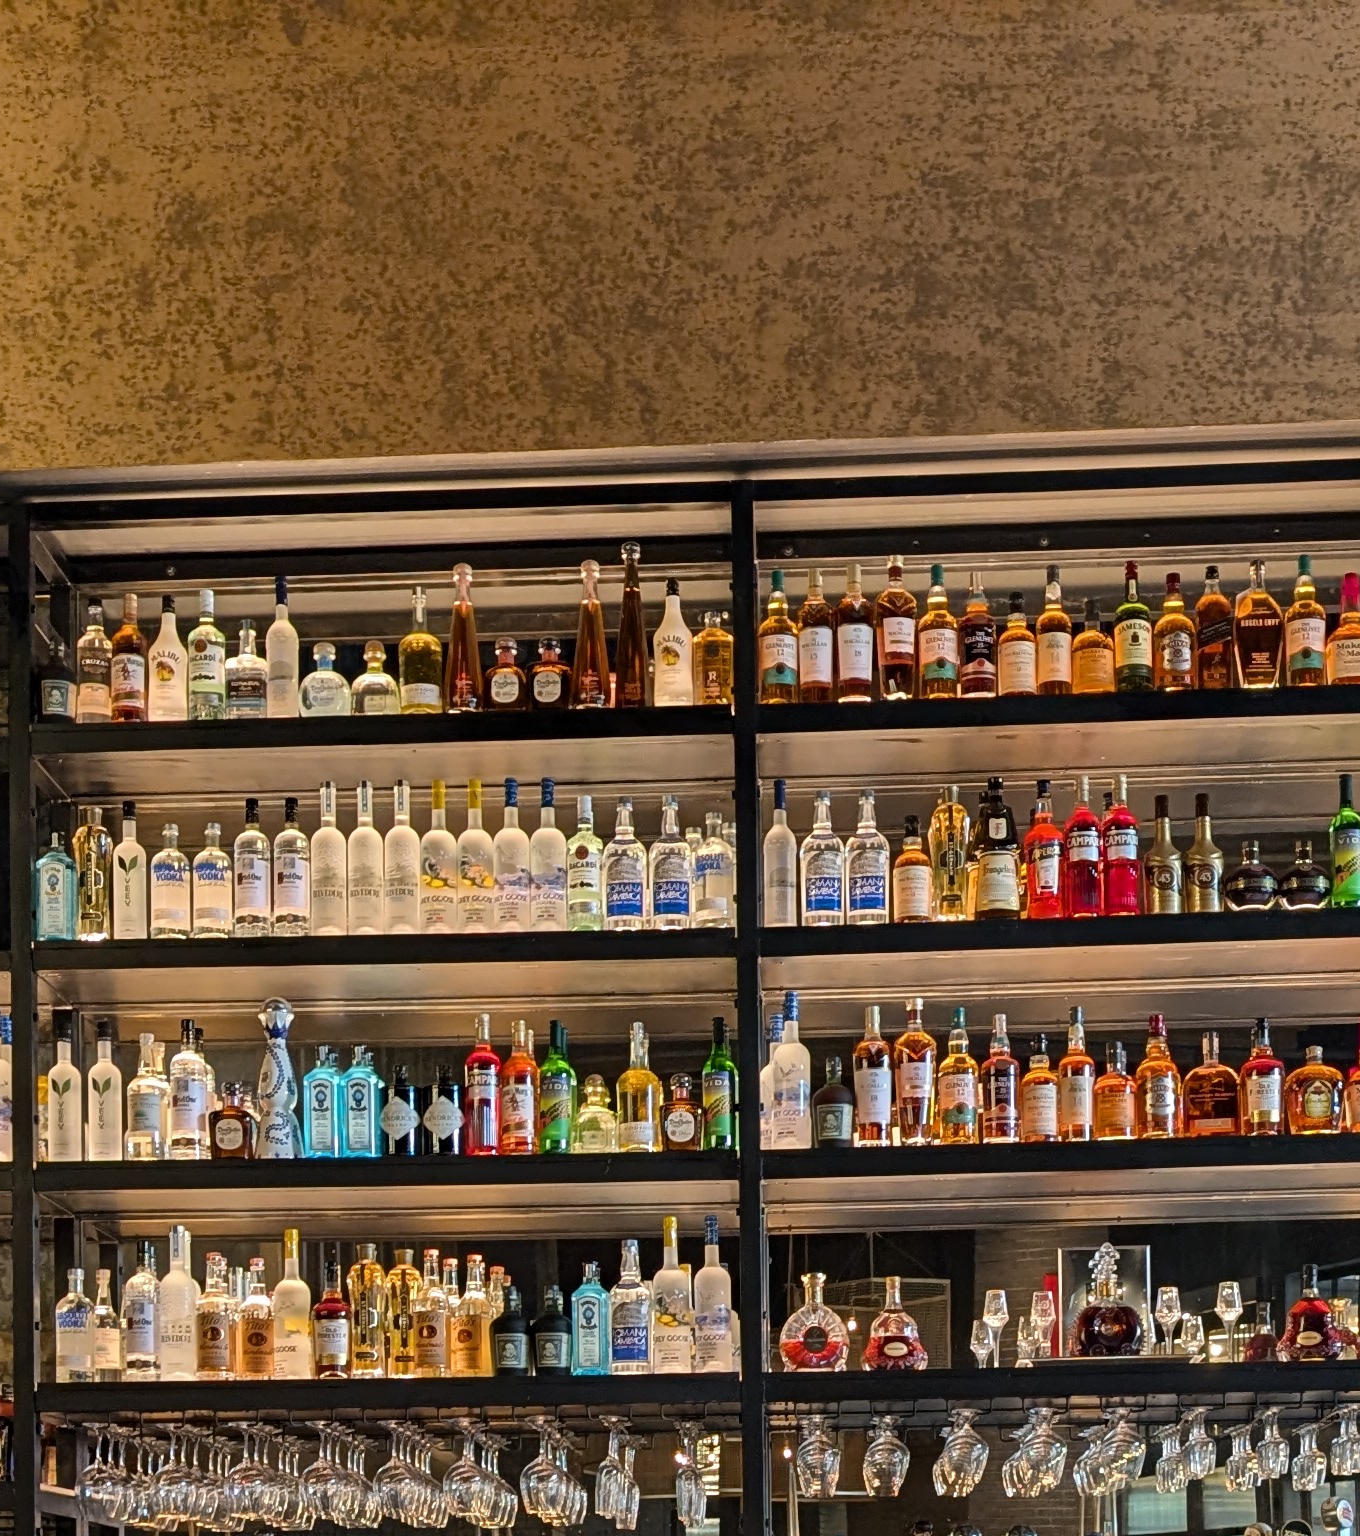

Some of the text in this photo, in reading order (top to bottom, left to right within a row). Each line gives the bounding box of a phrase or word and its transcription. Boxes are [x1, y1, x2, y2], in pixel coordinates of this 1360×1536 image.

[655, 634, 686, 647] MALIBU
[151, 650, 180, 664] MALIBU
[156, 873, 184, 882] VODKA
[197, 873, 225, 882] VODKA
[1158, 873, 1170, 883] 43
[1199, 872, 1211, 882] 43
[543, 1083, 568, 1091] VIDA
[957, 1088, 966, 1096] 12
[245, 1321, 270, 1330] Tito's
